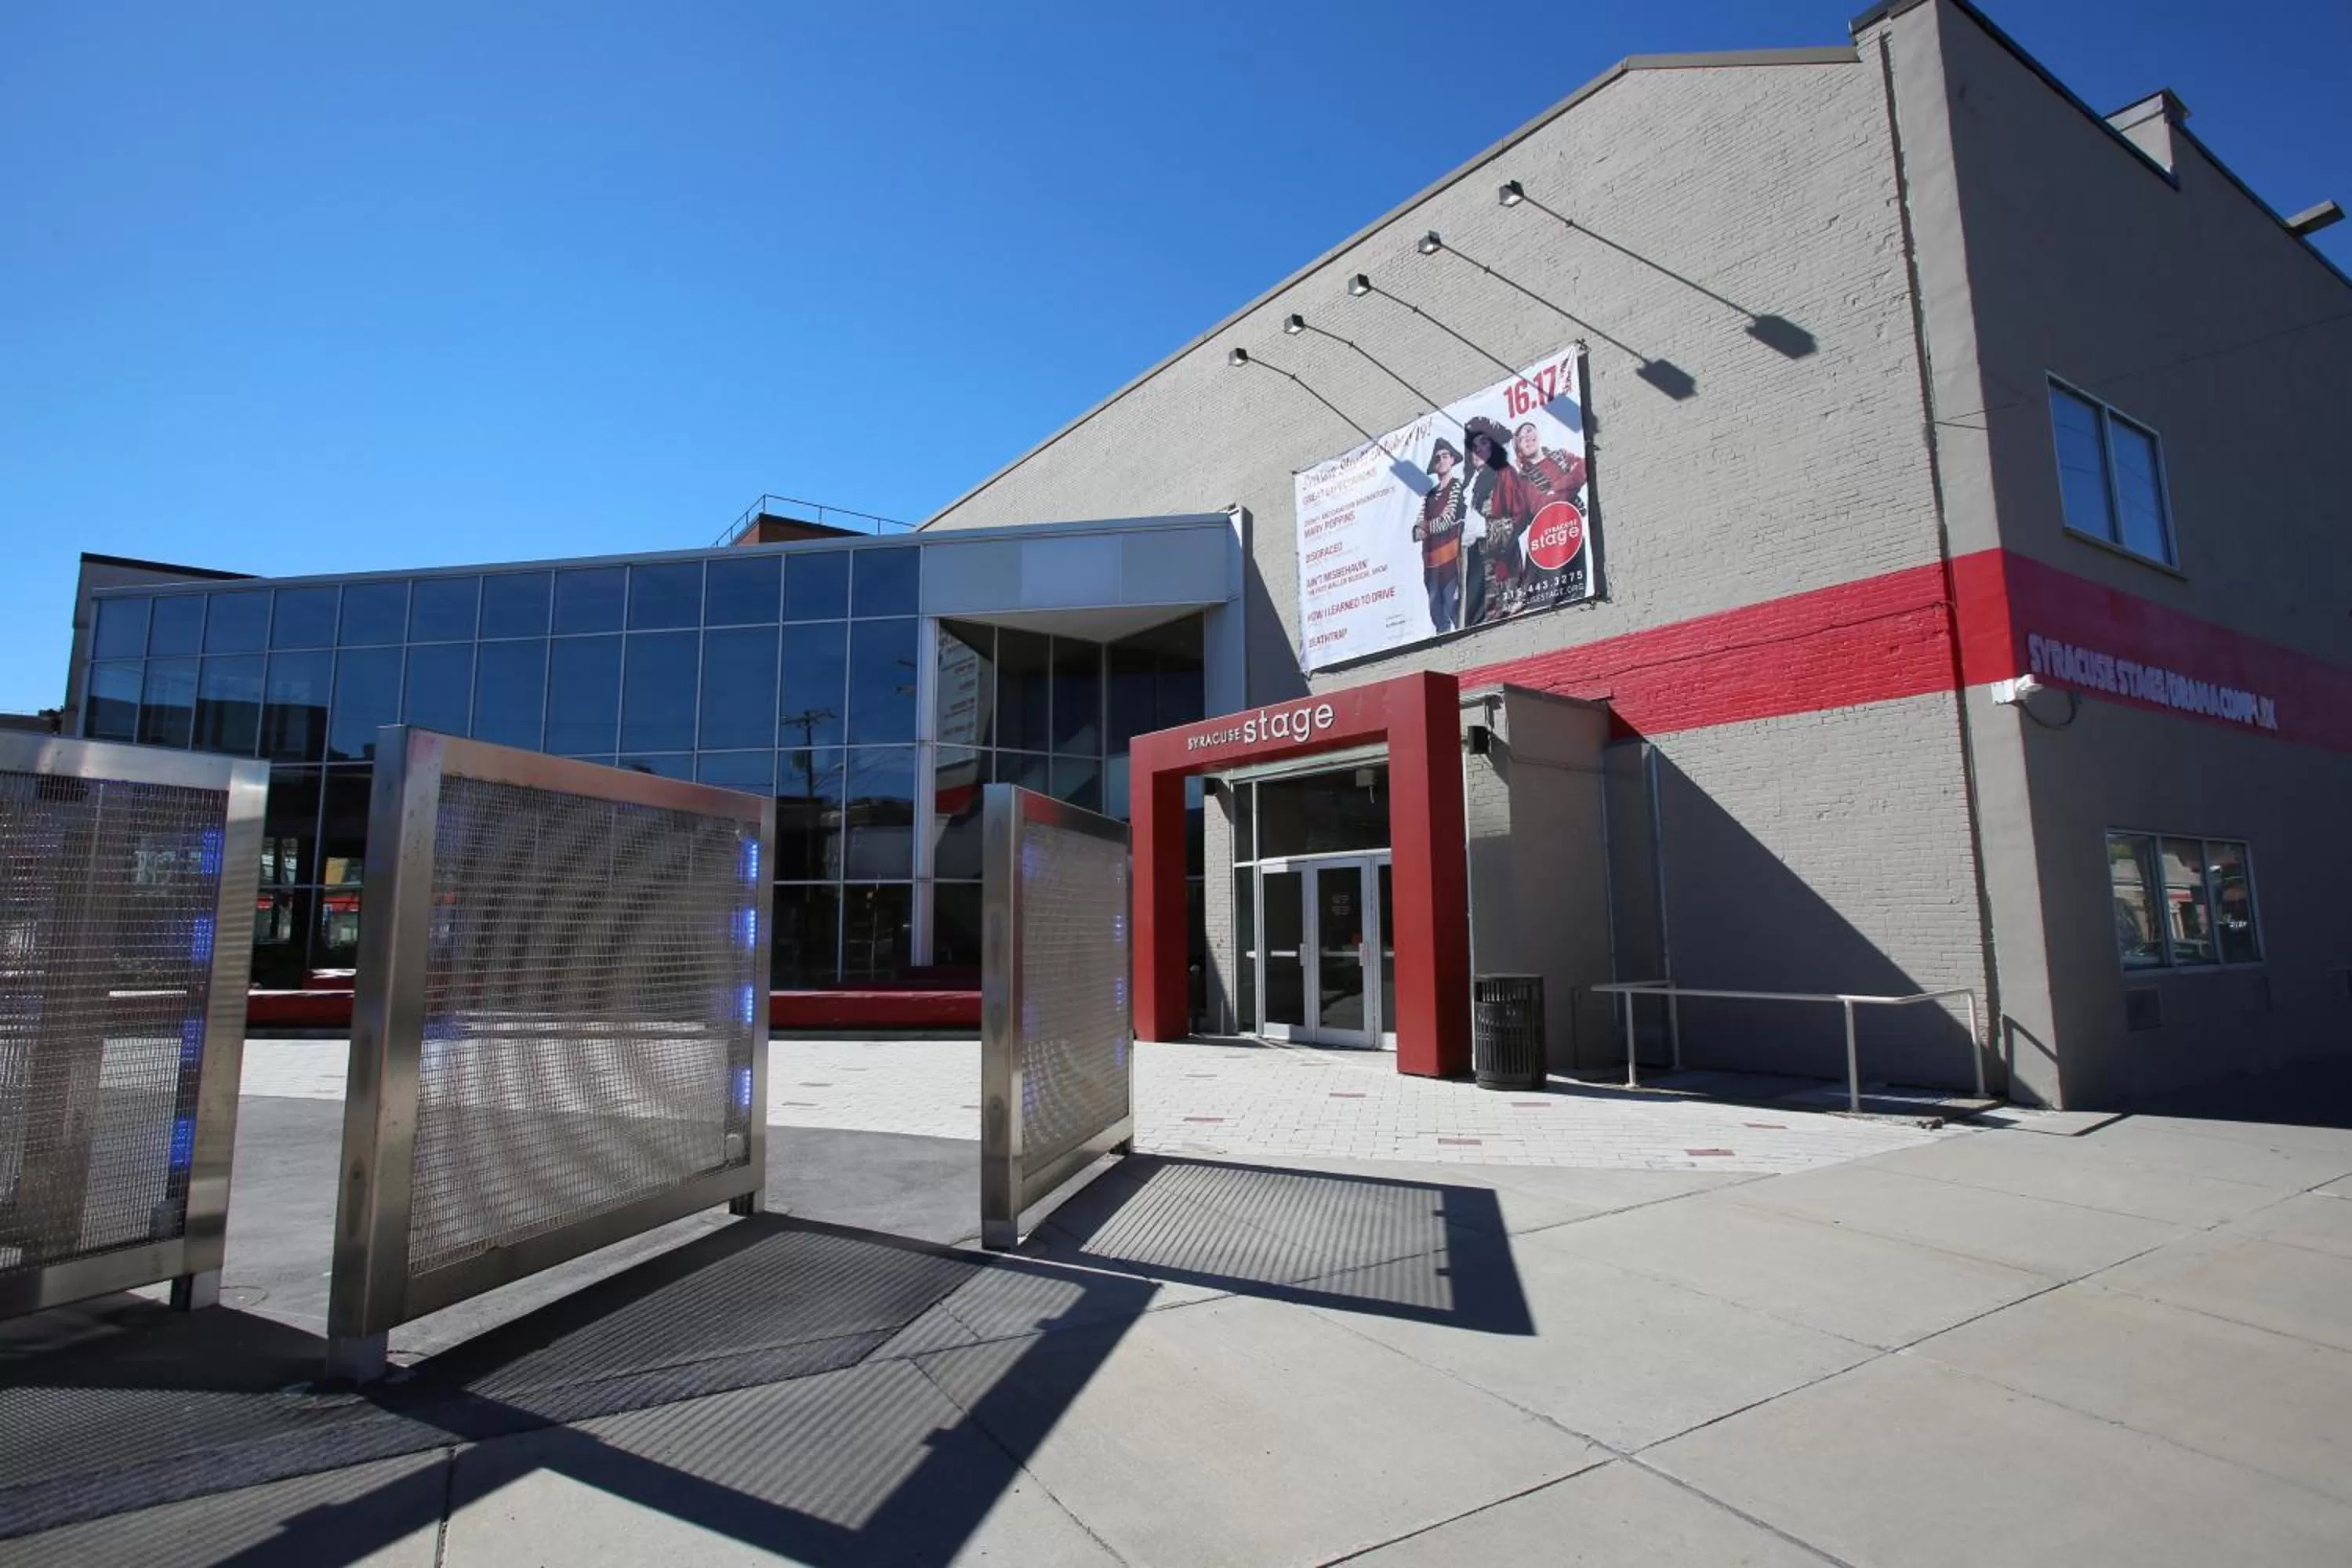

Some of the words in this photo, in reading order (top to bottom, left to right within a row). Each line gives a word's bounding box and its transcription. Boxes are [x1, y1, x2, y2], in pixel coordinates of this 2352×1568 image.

[1504, 365, 1556, 419] 16.17
[1530, 525, 1580, 551] stage
[1327, 597, 1360, 615] LEARNED
[1361, 593, 1371, 604] TO
[1371, 586, 1396, 603] DRIVE
[1187, 728, 1241, 751] SYRACUSE
[1243, 704, 1334, 743] stage
